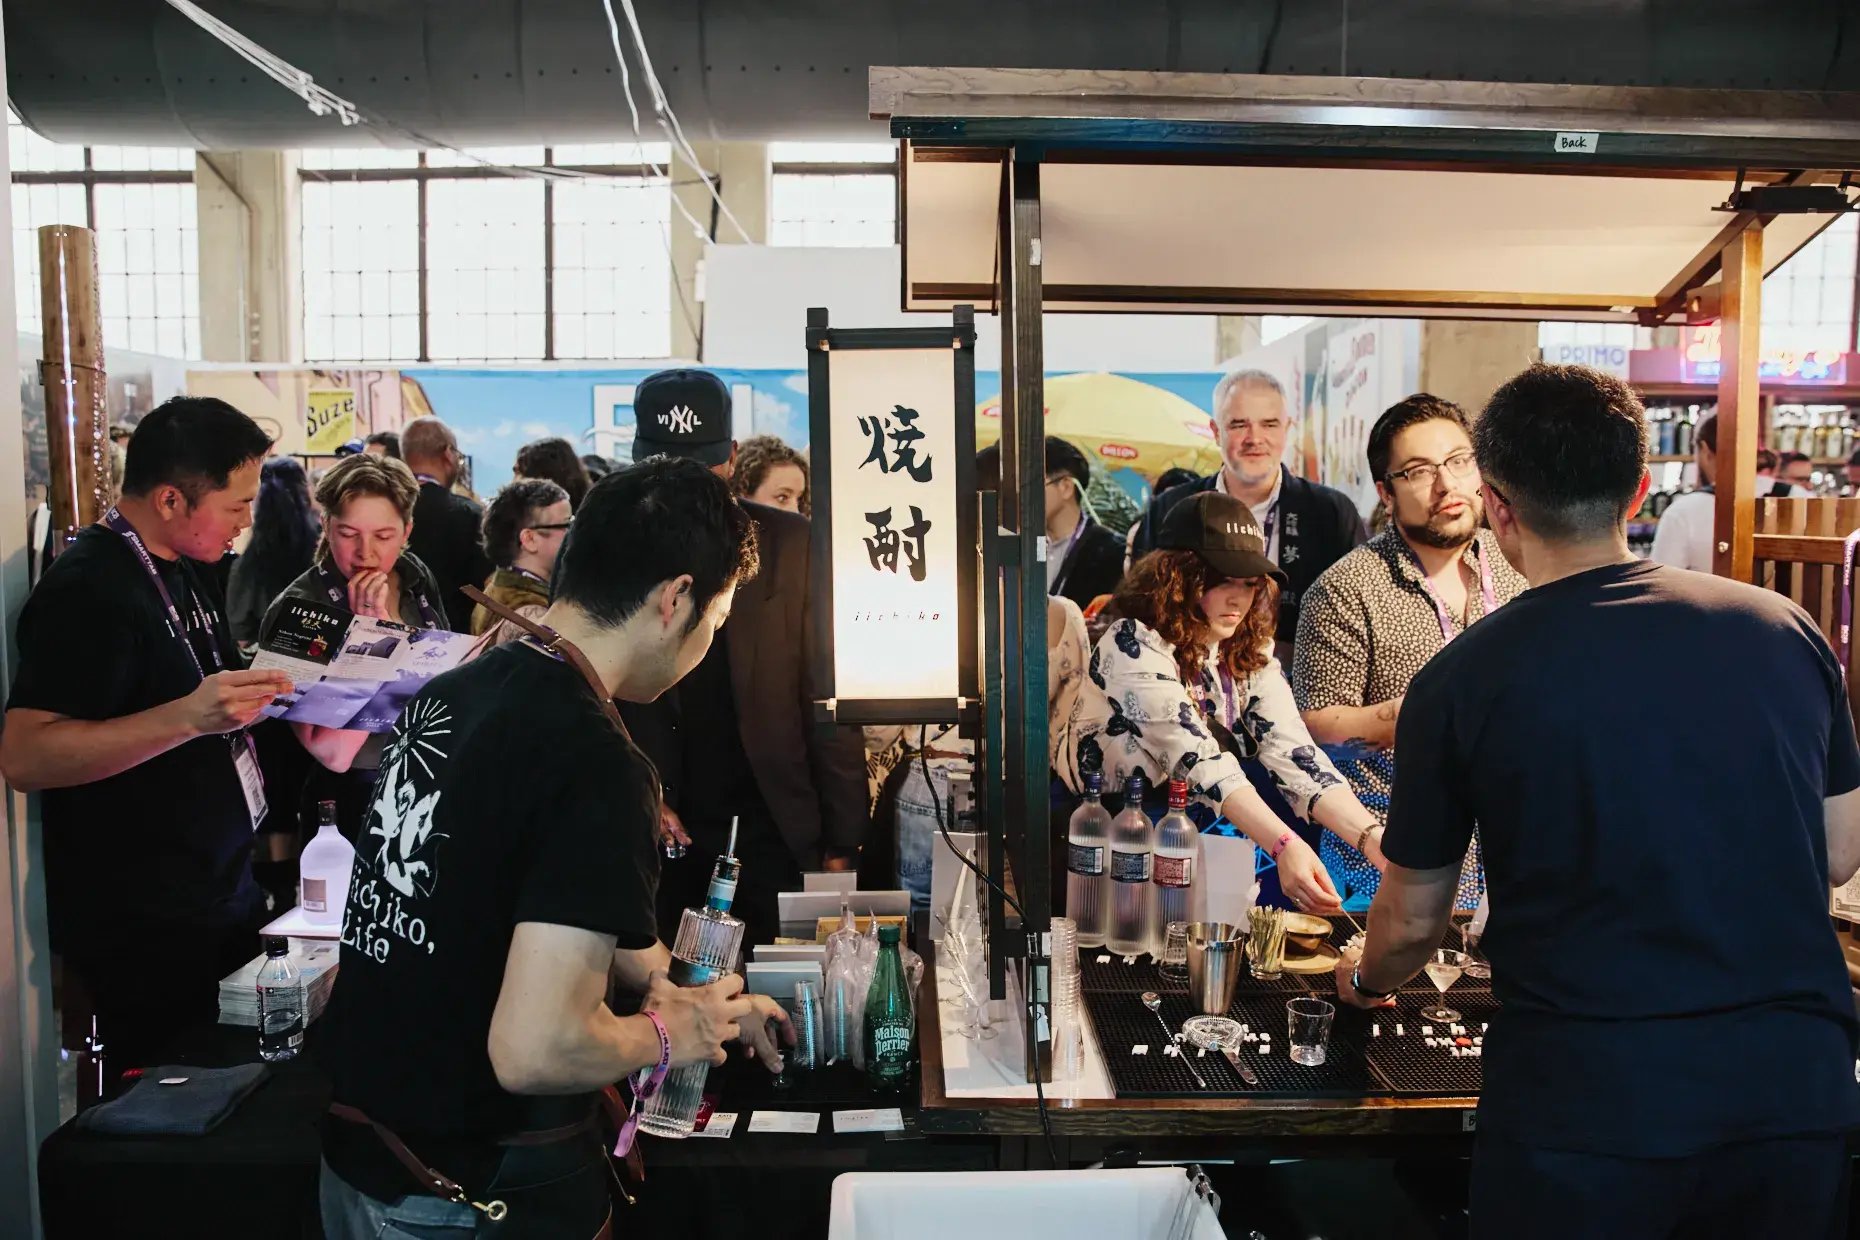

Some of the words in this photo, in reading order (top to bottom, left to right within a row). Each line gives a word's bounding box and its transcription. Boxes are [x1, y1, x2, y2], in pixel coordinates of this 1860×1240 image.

[1561, 135, 1588, 149] Back
[1559, 345, 1625, 366] PRIMO
[307, 398, 353, 437] Suze
[857, 405, 933, 582] 焼酎
[340, 907, 390, 964] Life
[875, 1024, 911, 1041] Maison
